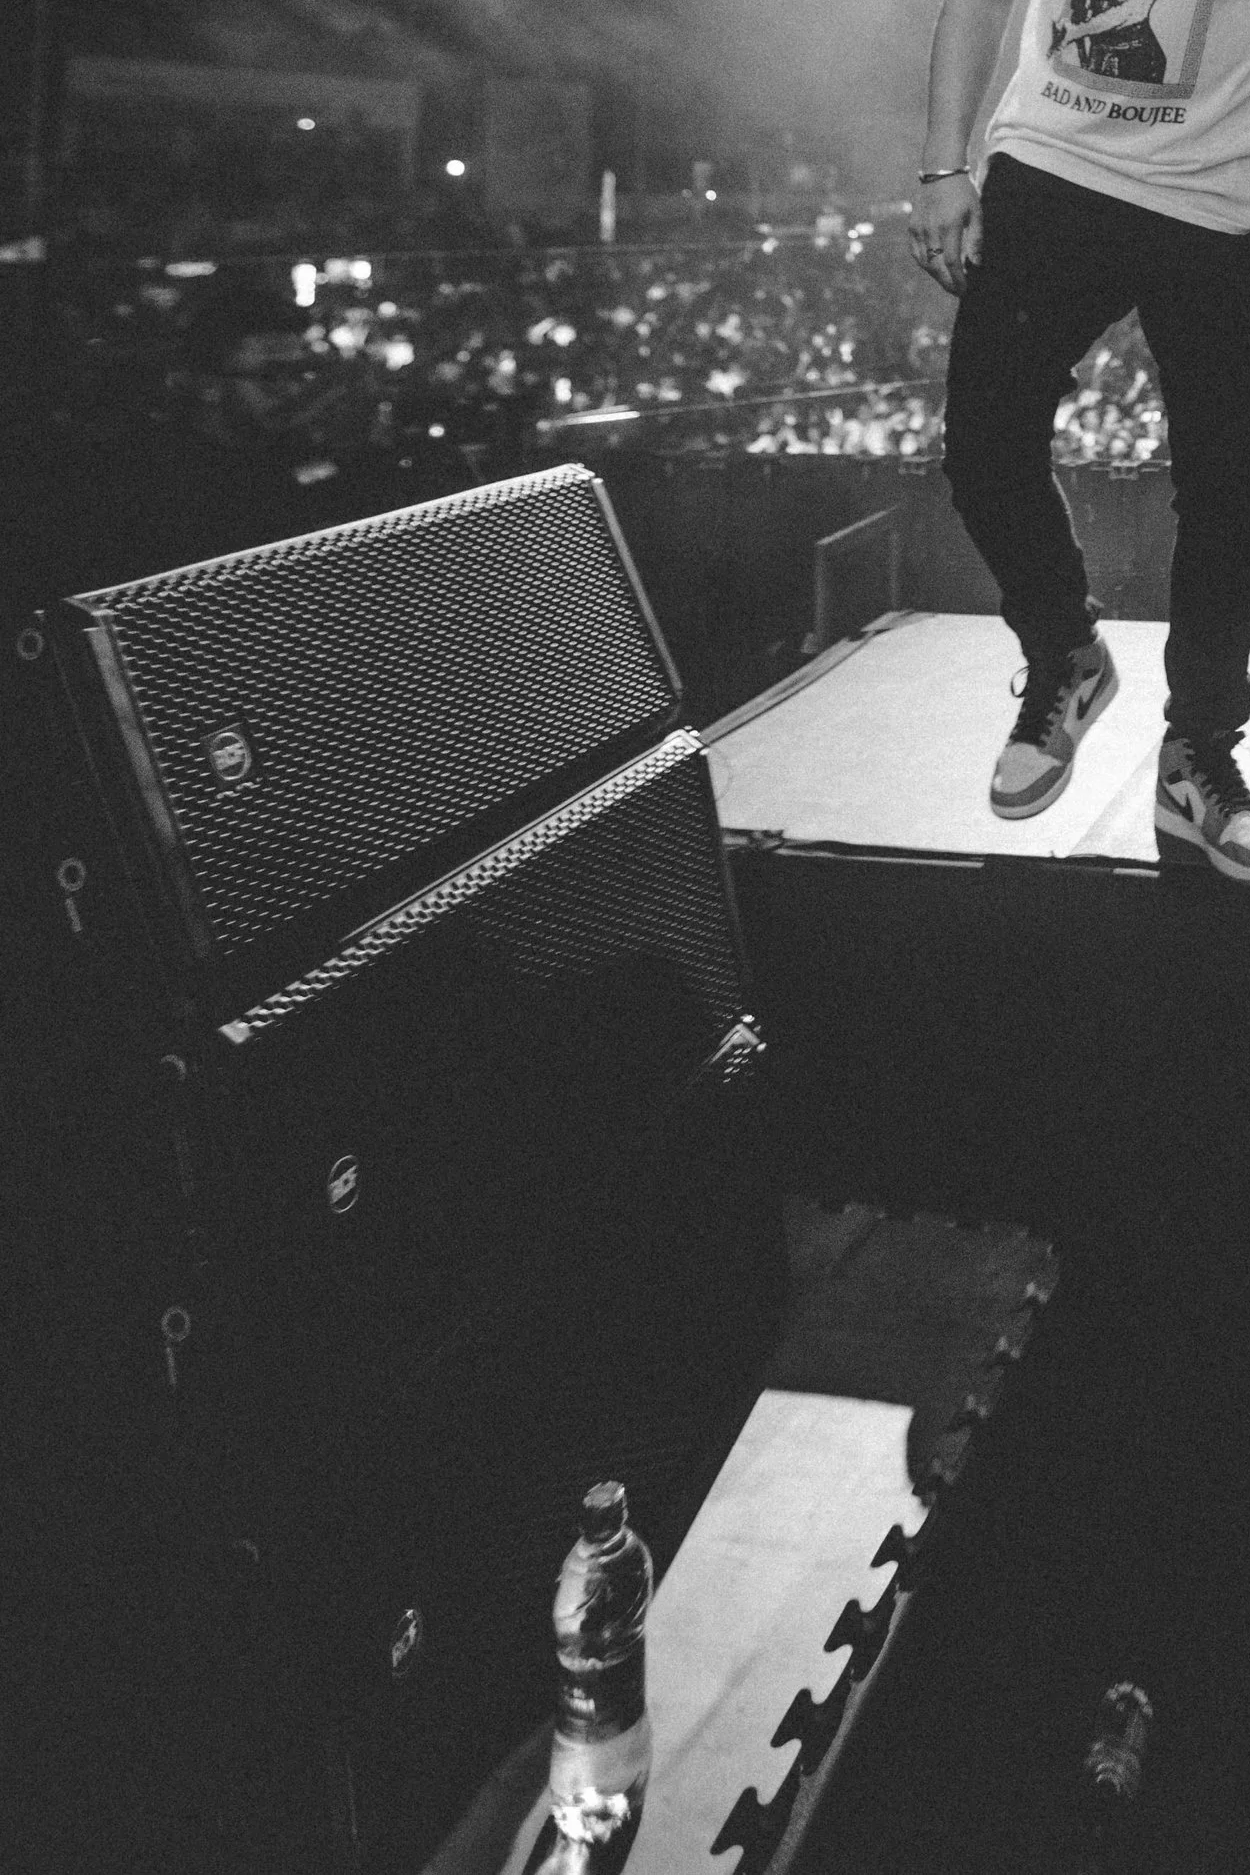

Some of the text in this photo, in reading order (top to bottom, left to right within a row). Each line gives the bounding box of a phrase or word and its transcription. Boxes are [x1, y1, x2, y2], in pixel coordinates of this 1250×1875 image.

[1041, 81, 1186, 126] BAD AND BOUJEE
